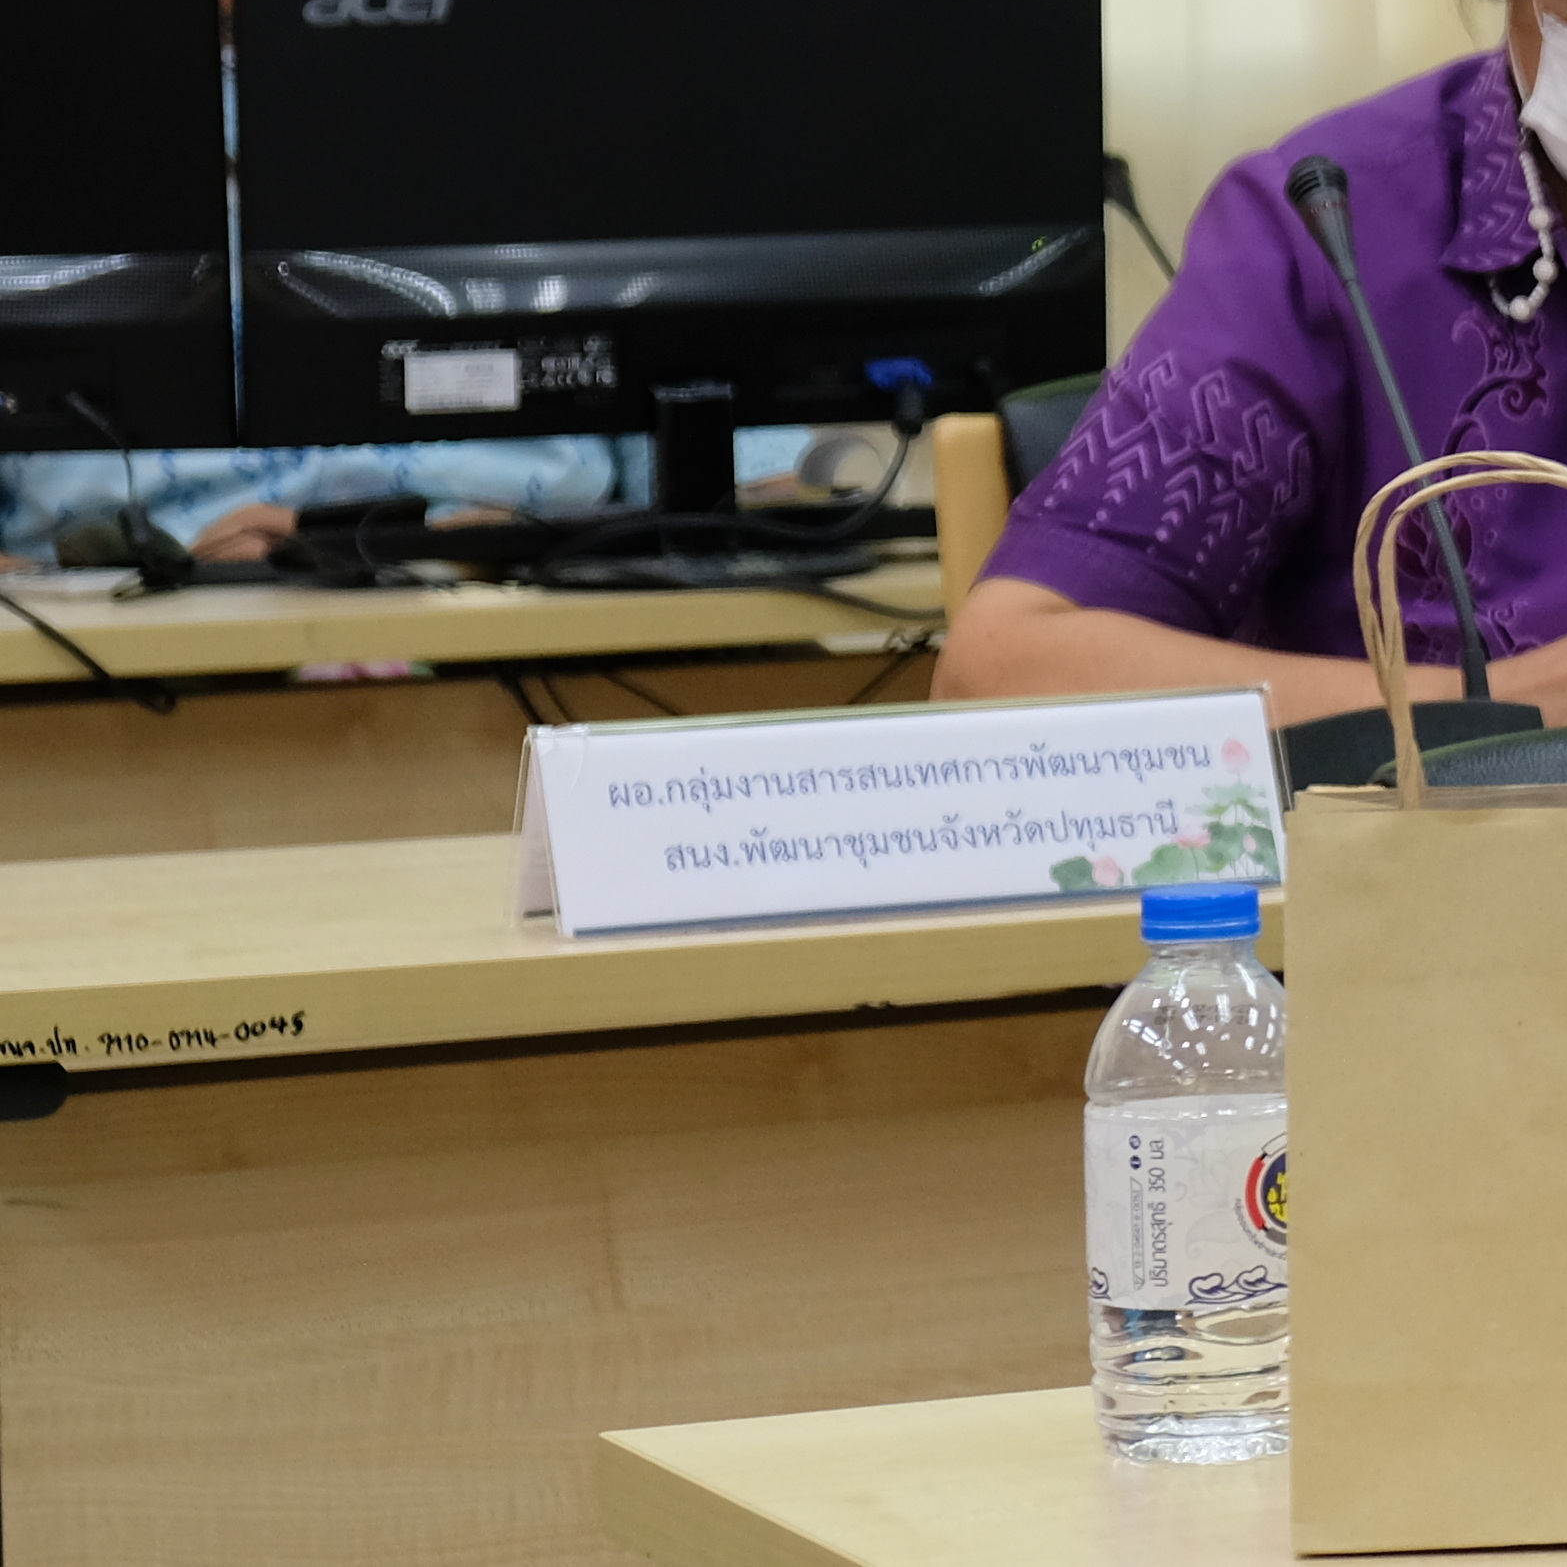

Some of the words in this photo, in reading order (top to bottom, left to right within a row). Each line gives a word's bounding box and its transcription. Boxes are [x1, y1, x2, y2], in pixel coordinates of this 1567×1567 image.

[607, 742, 1212, 818] ผอ.กลุ่มงานสารสนเทศการพัฒนาชุมชน
[664, 798, 1180, 873] สนง.พัฒนาชุมชนจังหวัดปทุมธานี
[1147, 1166, 1166, 1194] 350
[1146, 1201, 1173, 1288] ปริมาตรสุทธิ
